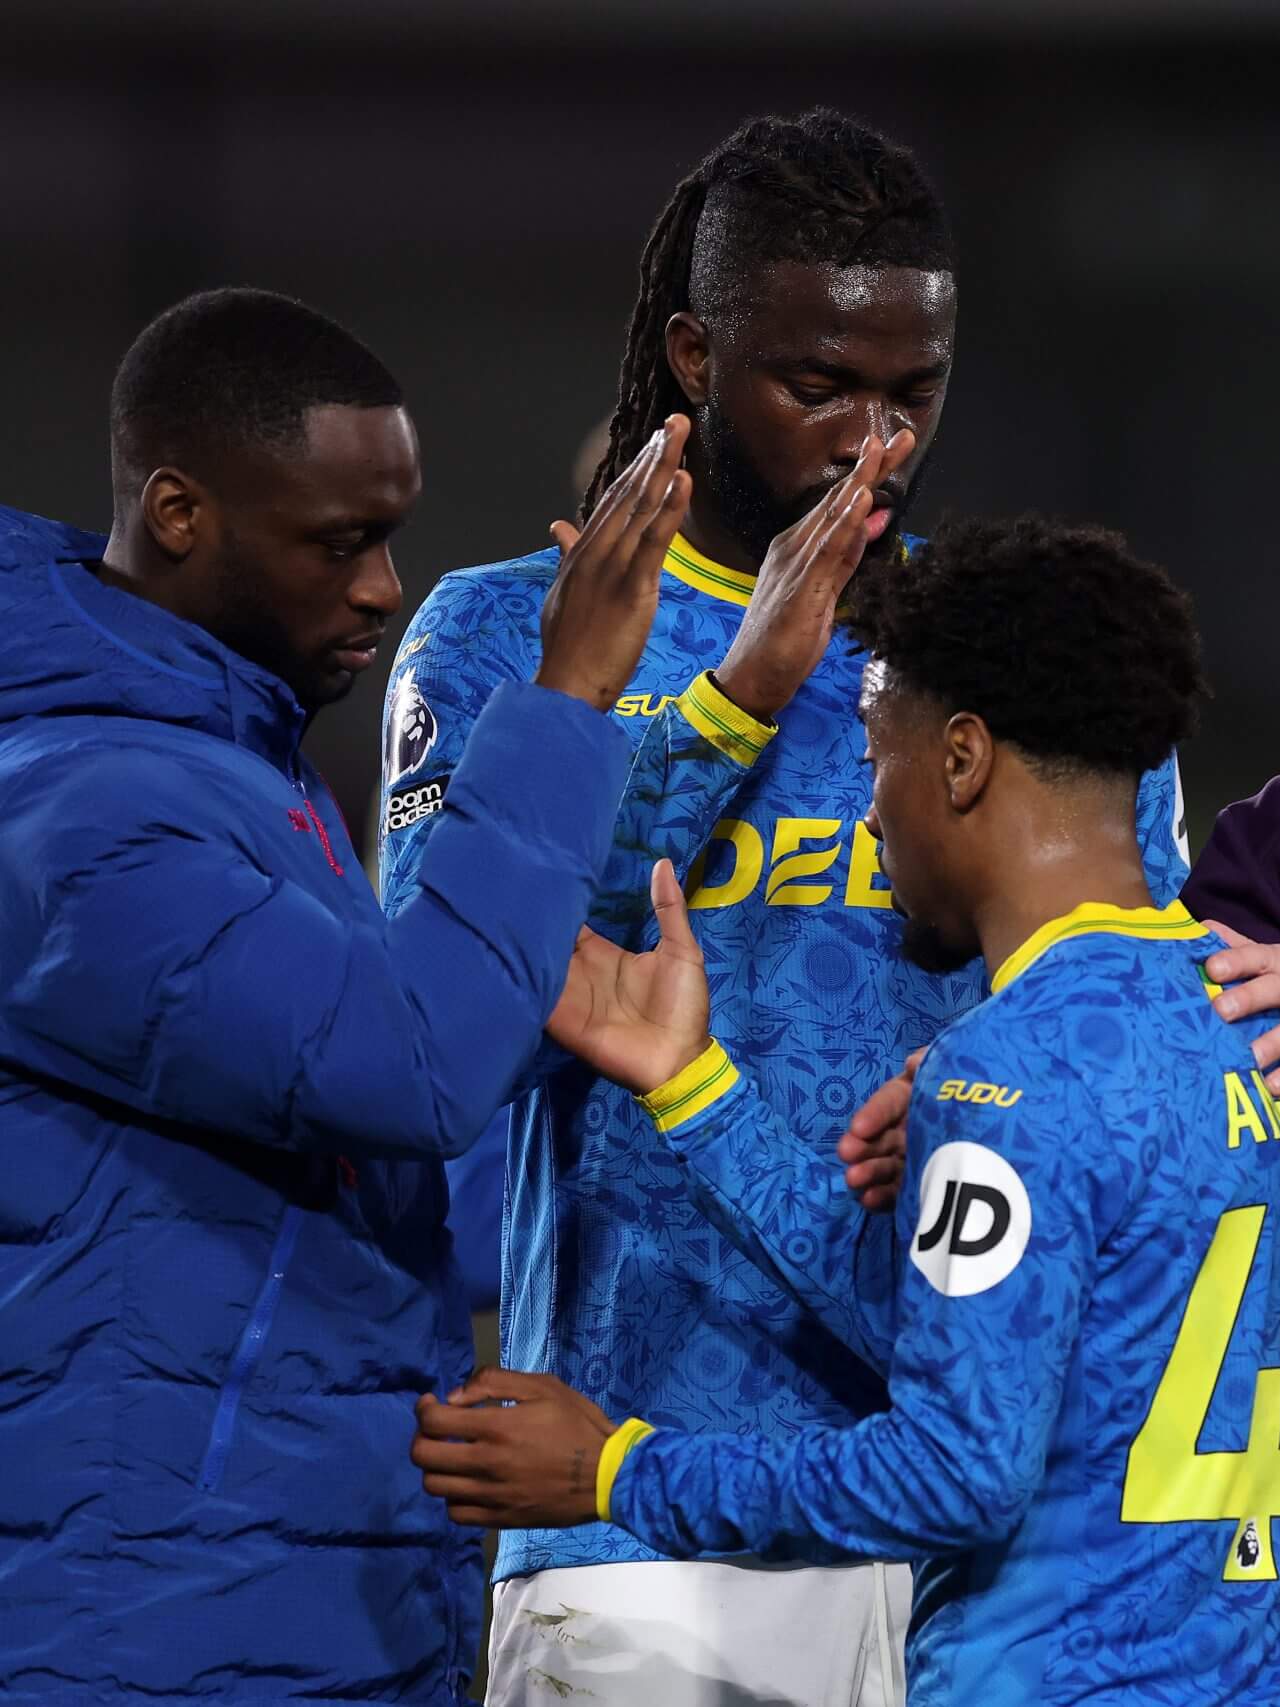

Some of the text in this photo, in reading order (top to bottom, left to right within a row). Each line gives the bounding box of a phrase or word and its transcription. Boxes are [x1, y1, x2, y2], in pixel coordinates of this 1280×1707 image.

[614, 693, 676, 717] SU
[388, 783, 442, 813] oom
[936, 1079, 1023, 1108] SUDU
[917, 1180, 1012, 1257] JD
